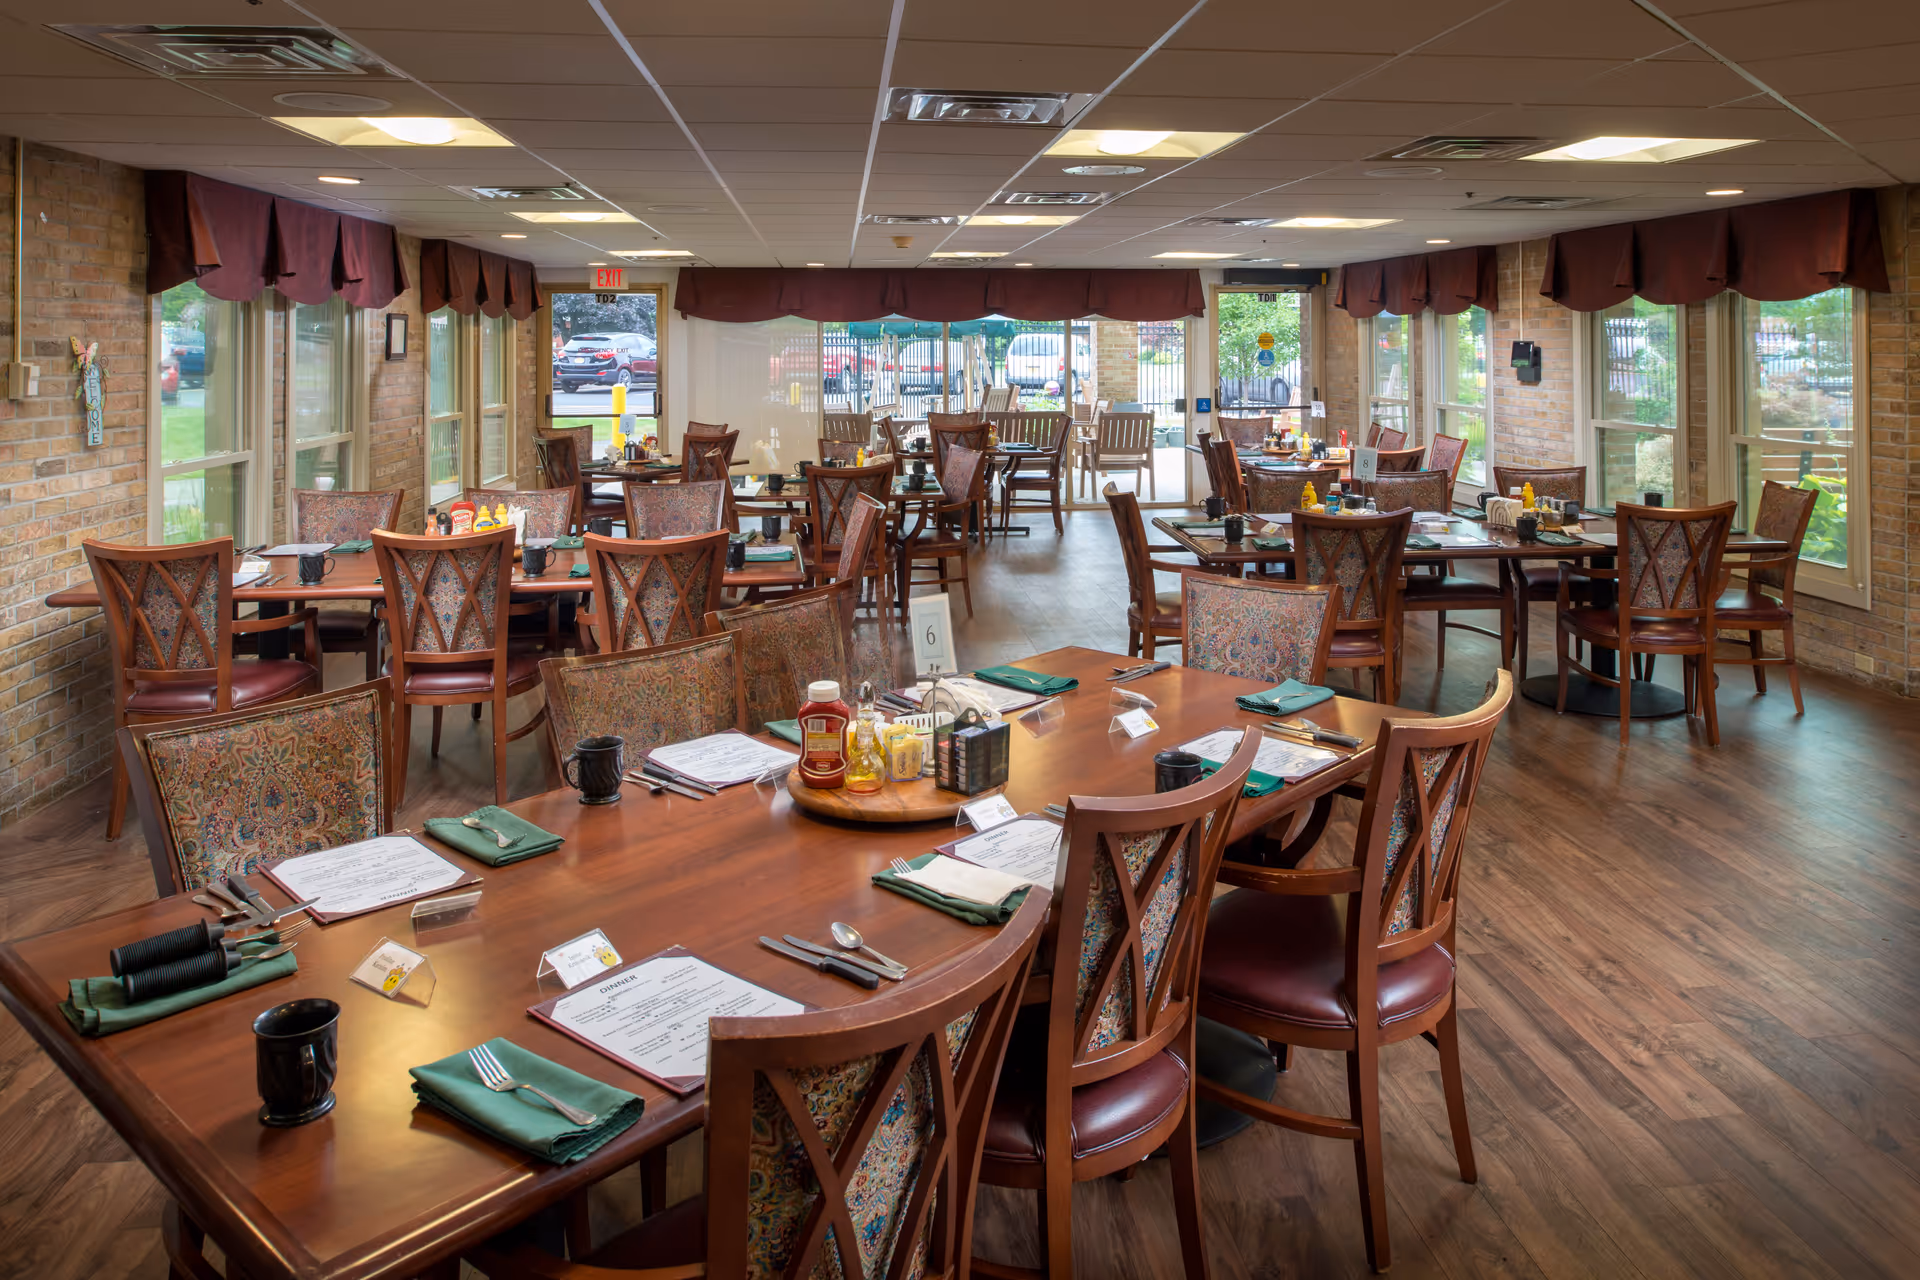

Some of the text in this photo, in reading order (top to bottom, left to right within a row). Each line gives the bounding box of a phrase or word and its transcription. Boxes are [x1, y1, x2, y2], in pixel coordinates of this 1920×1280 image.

[597, 268, 623, 287] EXIT
[596, 294, 616, 303] TD2
[87, 367, 100, 444] WELCOME
[1362, 459, 1369, 468] 8
[926, 624, 936, 646] 6
[599, 974, 638, 994] DINNER
